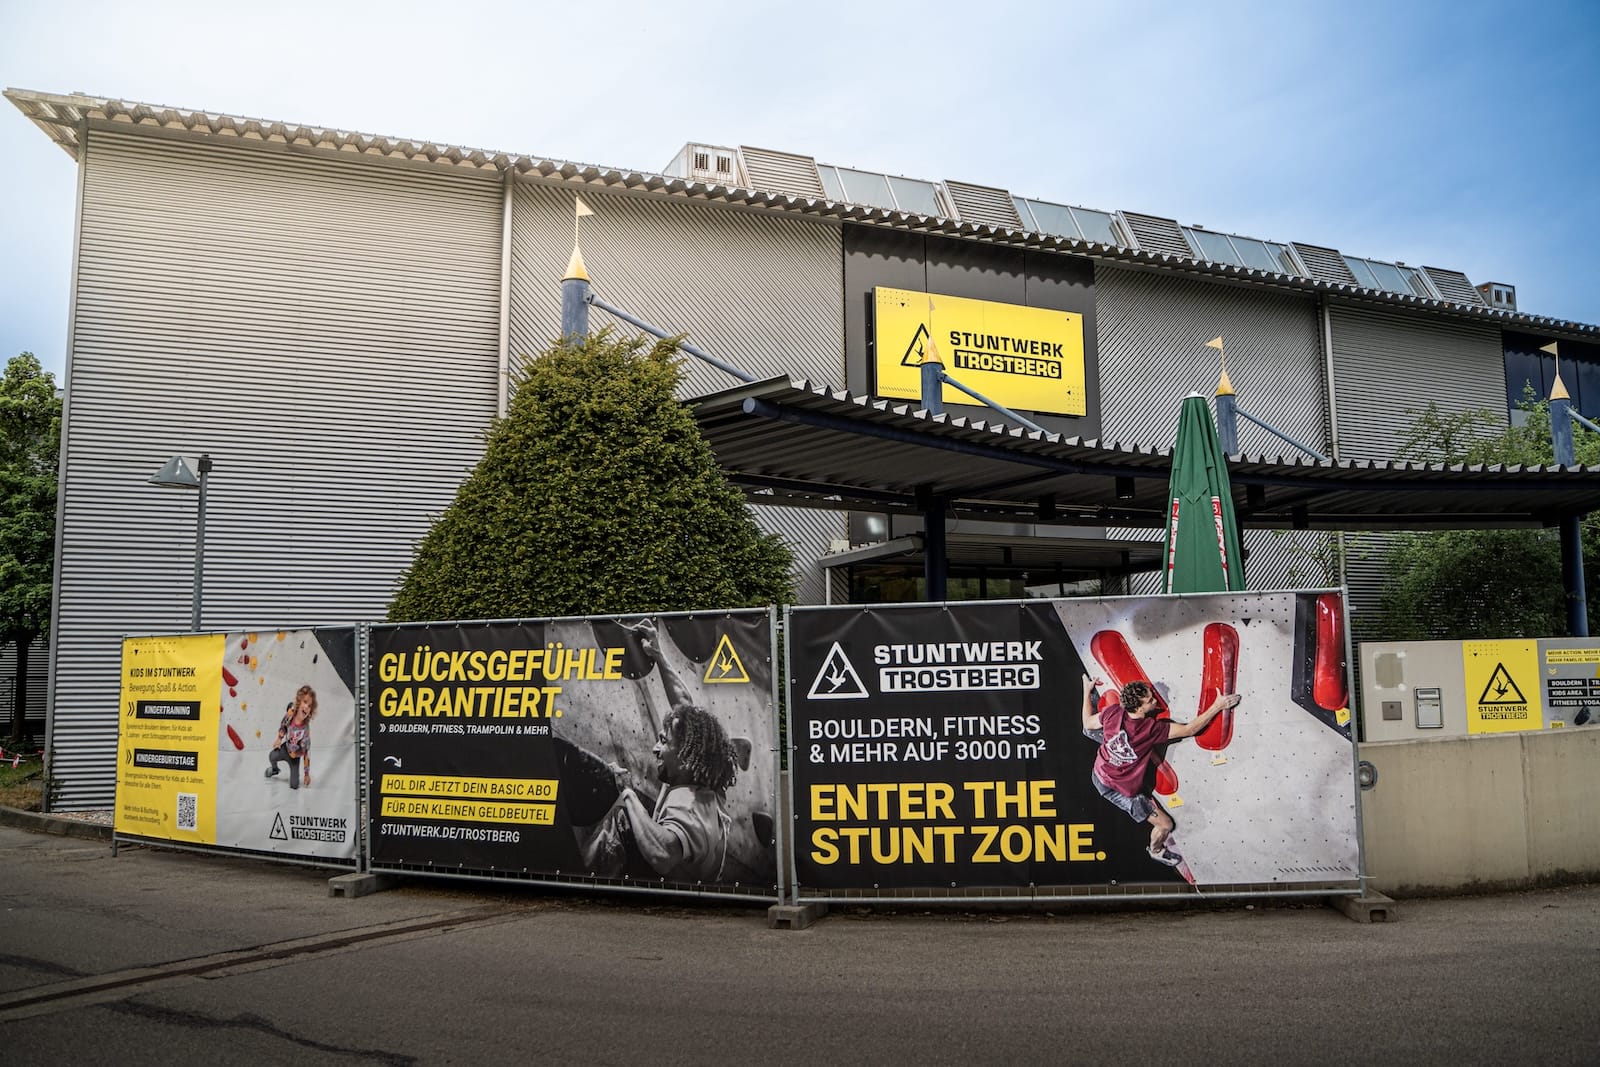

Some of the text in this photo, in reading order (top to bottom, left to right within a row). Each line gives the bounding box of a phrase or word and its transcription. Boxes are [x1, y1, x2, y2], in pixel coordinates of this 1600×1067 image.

[950, 331, 1064, 358] STUNTWERK
[956, 351, 1060, 378] TROSTBERG
[379, 642, 625, 683] GLÜCKSGEFÜHLE
[874, 640, 1044, 665] STUNTWERK
[130, 667, 196, 678] KIDS IM STUNTWERK
[884, 667, 1035, 690] TROSTBERG
[172, 683, 177, 692] &
[144, 705, 191, 716] KINDERTRAINING
[379, 686, 563, 719] GARANTIERT.
[389, 723, 549, 736] BOULDERN, FITNESS, TRAMPOLIN & MEHR
[808, 715, 1041, 740] BOULDERN, FITNESS
[136, 753, 196, 766] KINDERGEBURTSTAGE
[809, 739, 1047, 764] & MEHR AUF 3000 m²
[386, 779, 552, 796] HOL DIR JETZT DEIN BASIC ABO
[810, 779, 1057, 821] ENTER THE
[386, 801, 550, 821] FÜR DEN KLEINEN GELDBEUTEL
[289, 815, 347, 829] STUNTWERK
[293, 828, 345, 842] TROSTBERG
[380, 823, 521, 843] STUNTWERK.DE/TROSTBERG
[810, 823, 1107, 865] STUNT ZONE.
